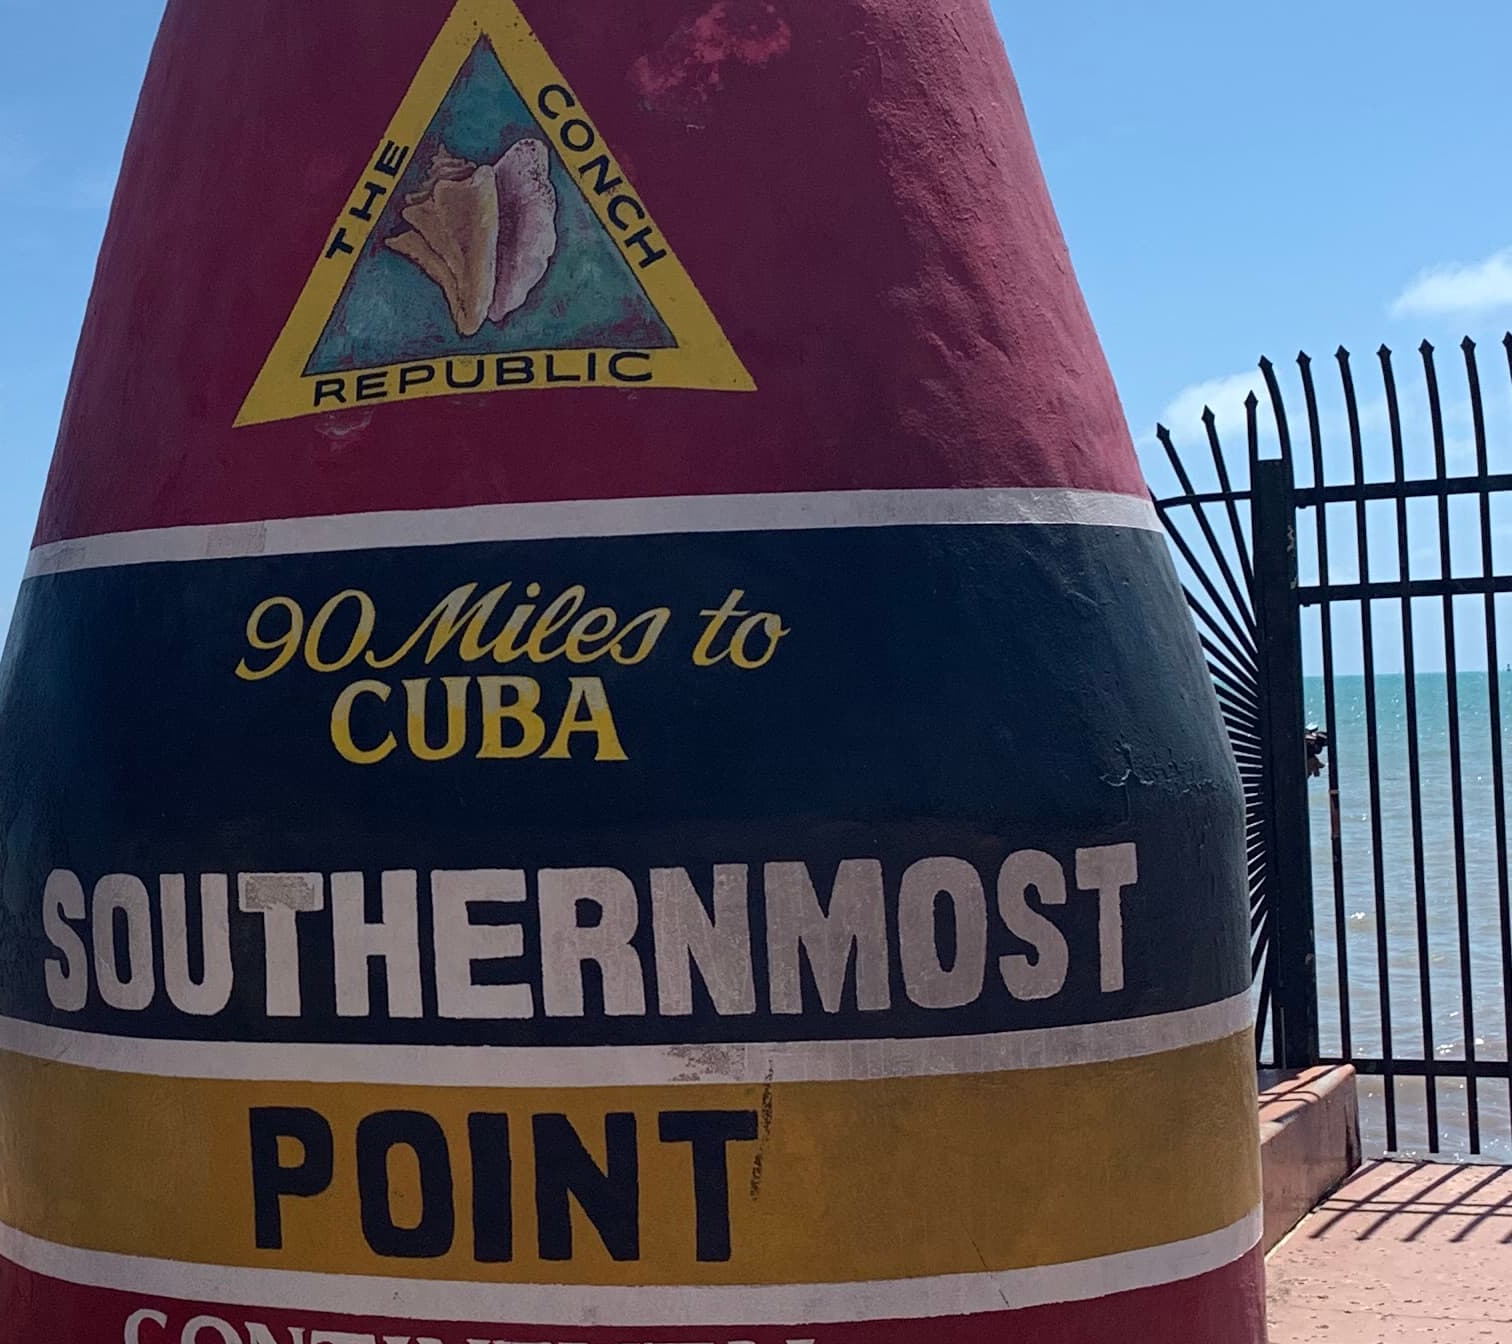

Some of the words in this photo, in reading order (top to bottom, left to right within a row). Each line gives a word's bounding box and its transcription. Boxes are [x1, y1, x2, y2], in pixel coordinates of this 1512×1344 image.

[325, 140, 410, 259] THE
[537, 84, 667, 269] CONCH
[313, 352, 654, 407] REPUBLIC
[234, 589, 377, 681] 90
[365, 582, 672, 670] Miles
[691, 589, 791, 670] to
[329, 675, 629, 766] CUBA
[41, 842, 1140, 1020] SOUTHERNMOST
[248, 1106, 759, 1265] POINT
